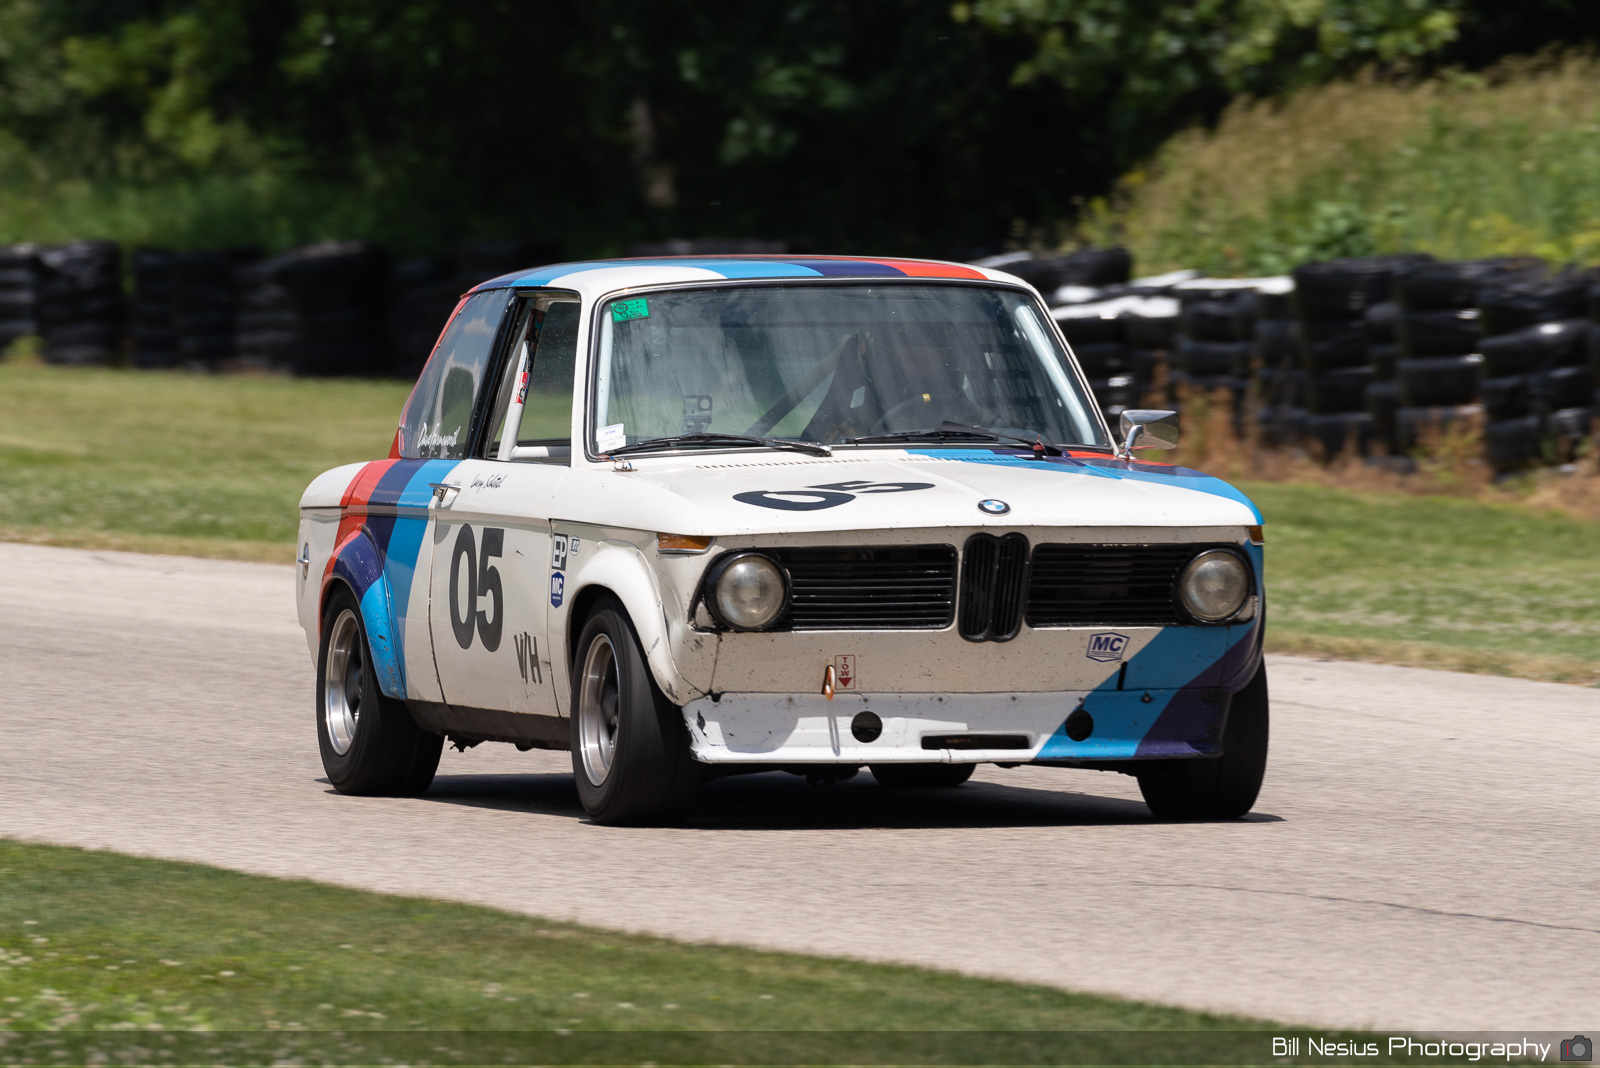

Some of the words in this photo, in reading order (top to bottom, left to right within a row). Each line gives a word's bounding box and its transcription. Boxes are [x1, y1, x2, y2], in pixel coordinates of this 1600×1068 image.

[732, 480, 936, 512] 05
[552, 535, 567, 568] EP
[449, 523, 504, 652] 05
[551, 577, 563, 595] MC
[1092, 636, 1123, 651] MC
[841, 656, 850, 676] TOW
